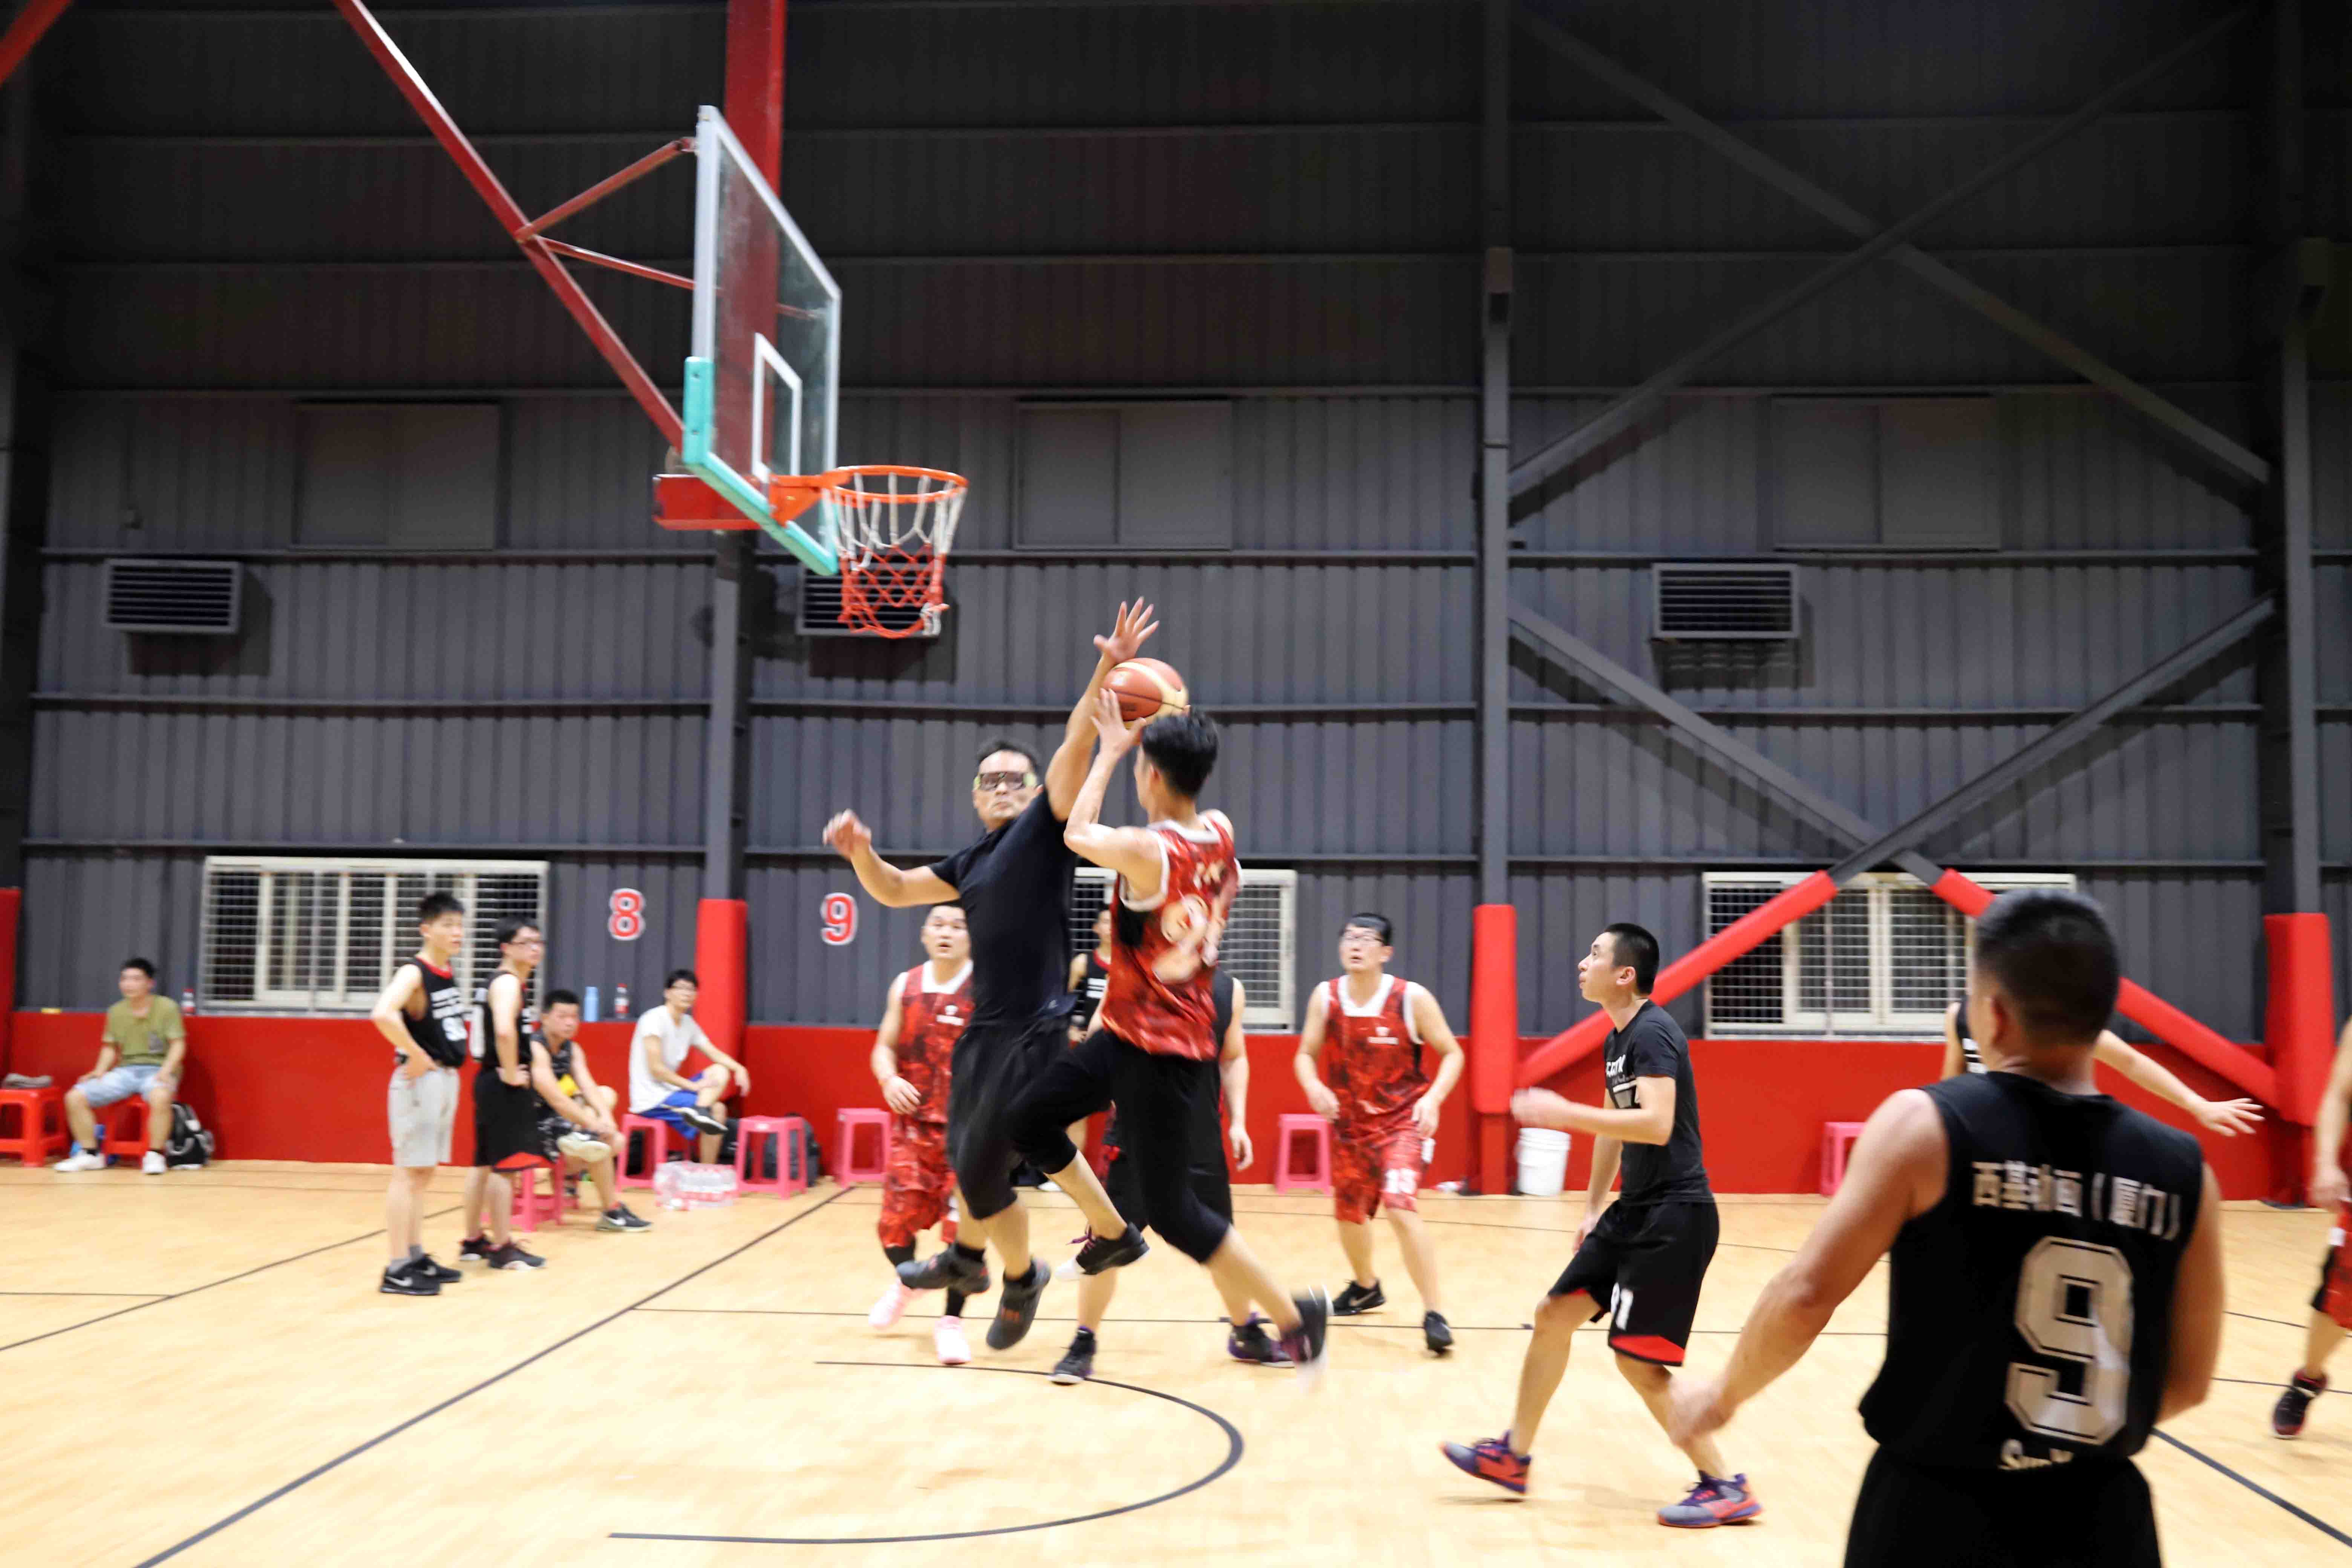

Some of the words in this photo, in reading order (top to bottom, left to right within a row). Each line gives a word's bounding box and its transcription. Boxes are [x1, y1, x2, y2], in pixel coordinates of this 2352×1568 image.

[608, 888, 646, 941] 8
[820, 892, 859, 945] 9
[2004, 1235, 2135, 1446] 9
